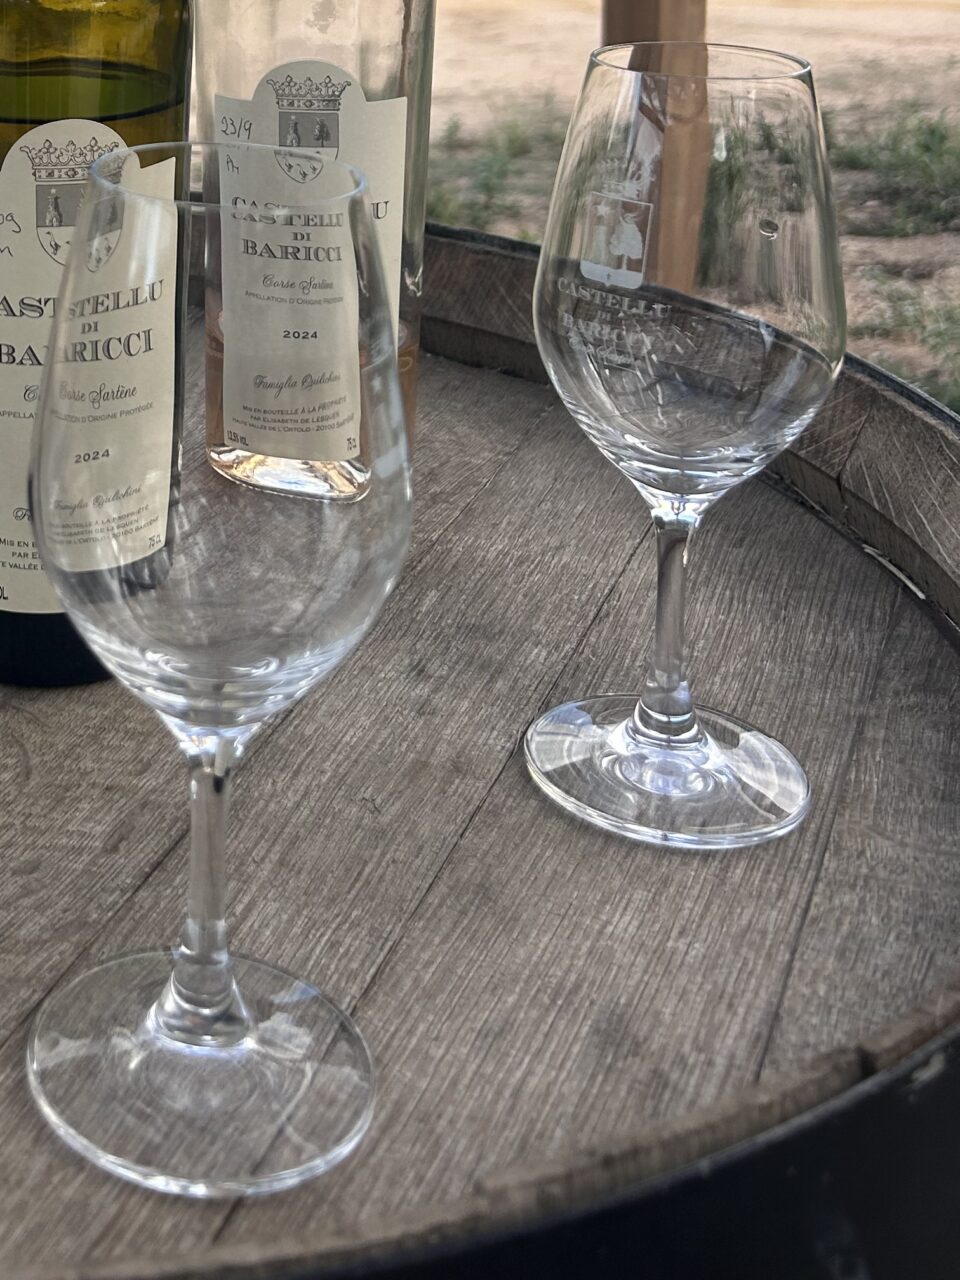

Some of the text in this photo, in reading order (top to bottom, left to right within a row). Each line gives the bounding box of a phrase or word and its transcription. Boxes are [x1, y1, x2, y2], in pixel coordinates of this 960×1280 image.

[221, 116, 253, 140] 23/9
[292, 232, 311, 242] DI
[241, 238, 342, 263] BARICCI
[81, 320, 99, 334] DI
[283, 330, 319, 340] 2024
[88, 382, 138, 410] Sartène
[74, 448, 111, 465] 2024
[17, 540, 29, 548] EN
[11, 551, 29, 559] PAR
[8, 561, 39, 571] VALLÉE
